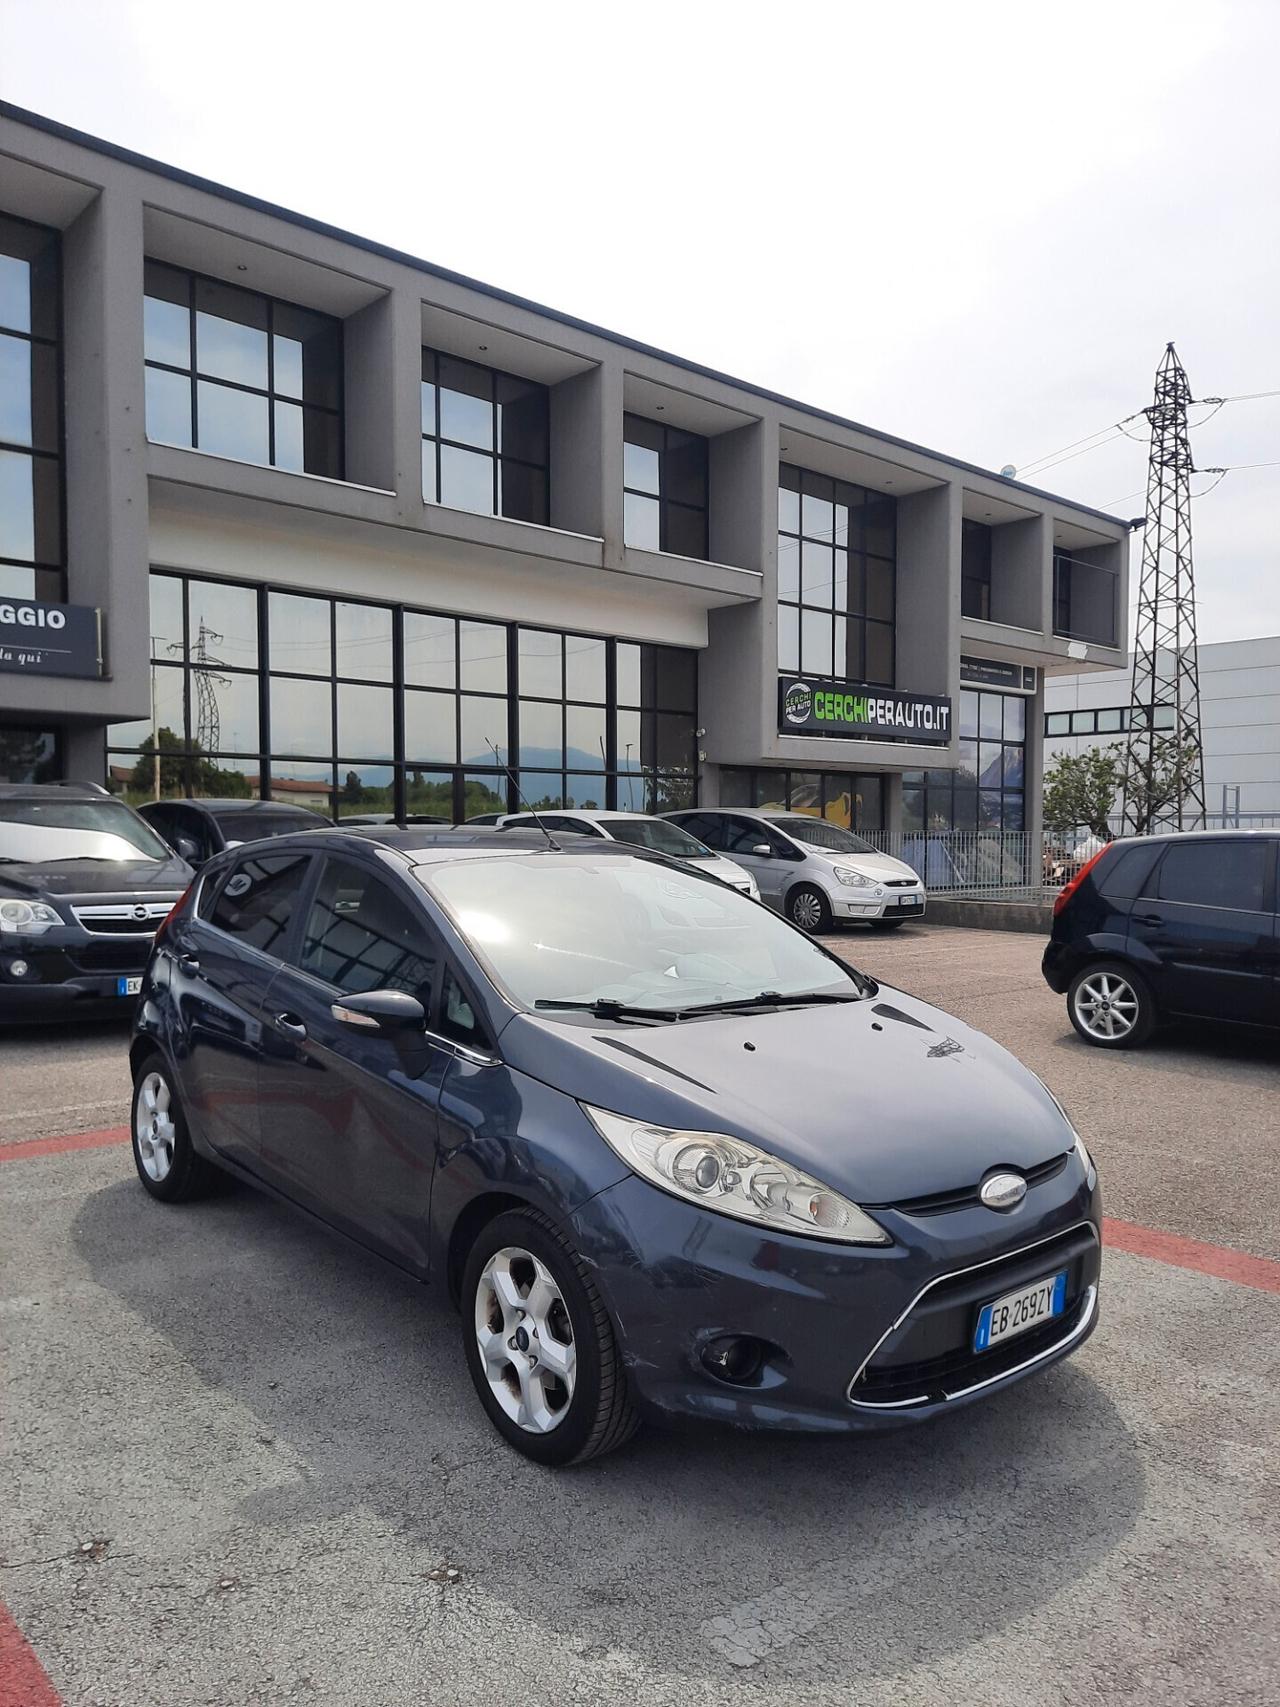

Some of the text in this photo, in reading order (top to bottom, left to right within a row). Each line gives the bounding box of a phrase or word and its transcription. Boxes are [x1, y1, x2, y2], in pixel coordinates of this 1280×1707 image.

[0, 604, 66, 629] GGIO
[18, 651, 42, 666] qui
[785, 692, 812, 707] CERCHI
[786, 700, 812, 714] PER AUTO
[814, 691, 949, 731] CERCHIPERAUTO.IT
[991, 1306, 1009, 1336] EB
[1012, 1285, 1054, 1327] 269ZY
